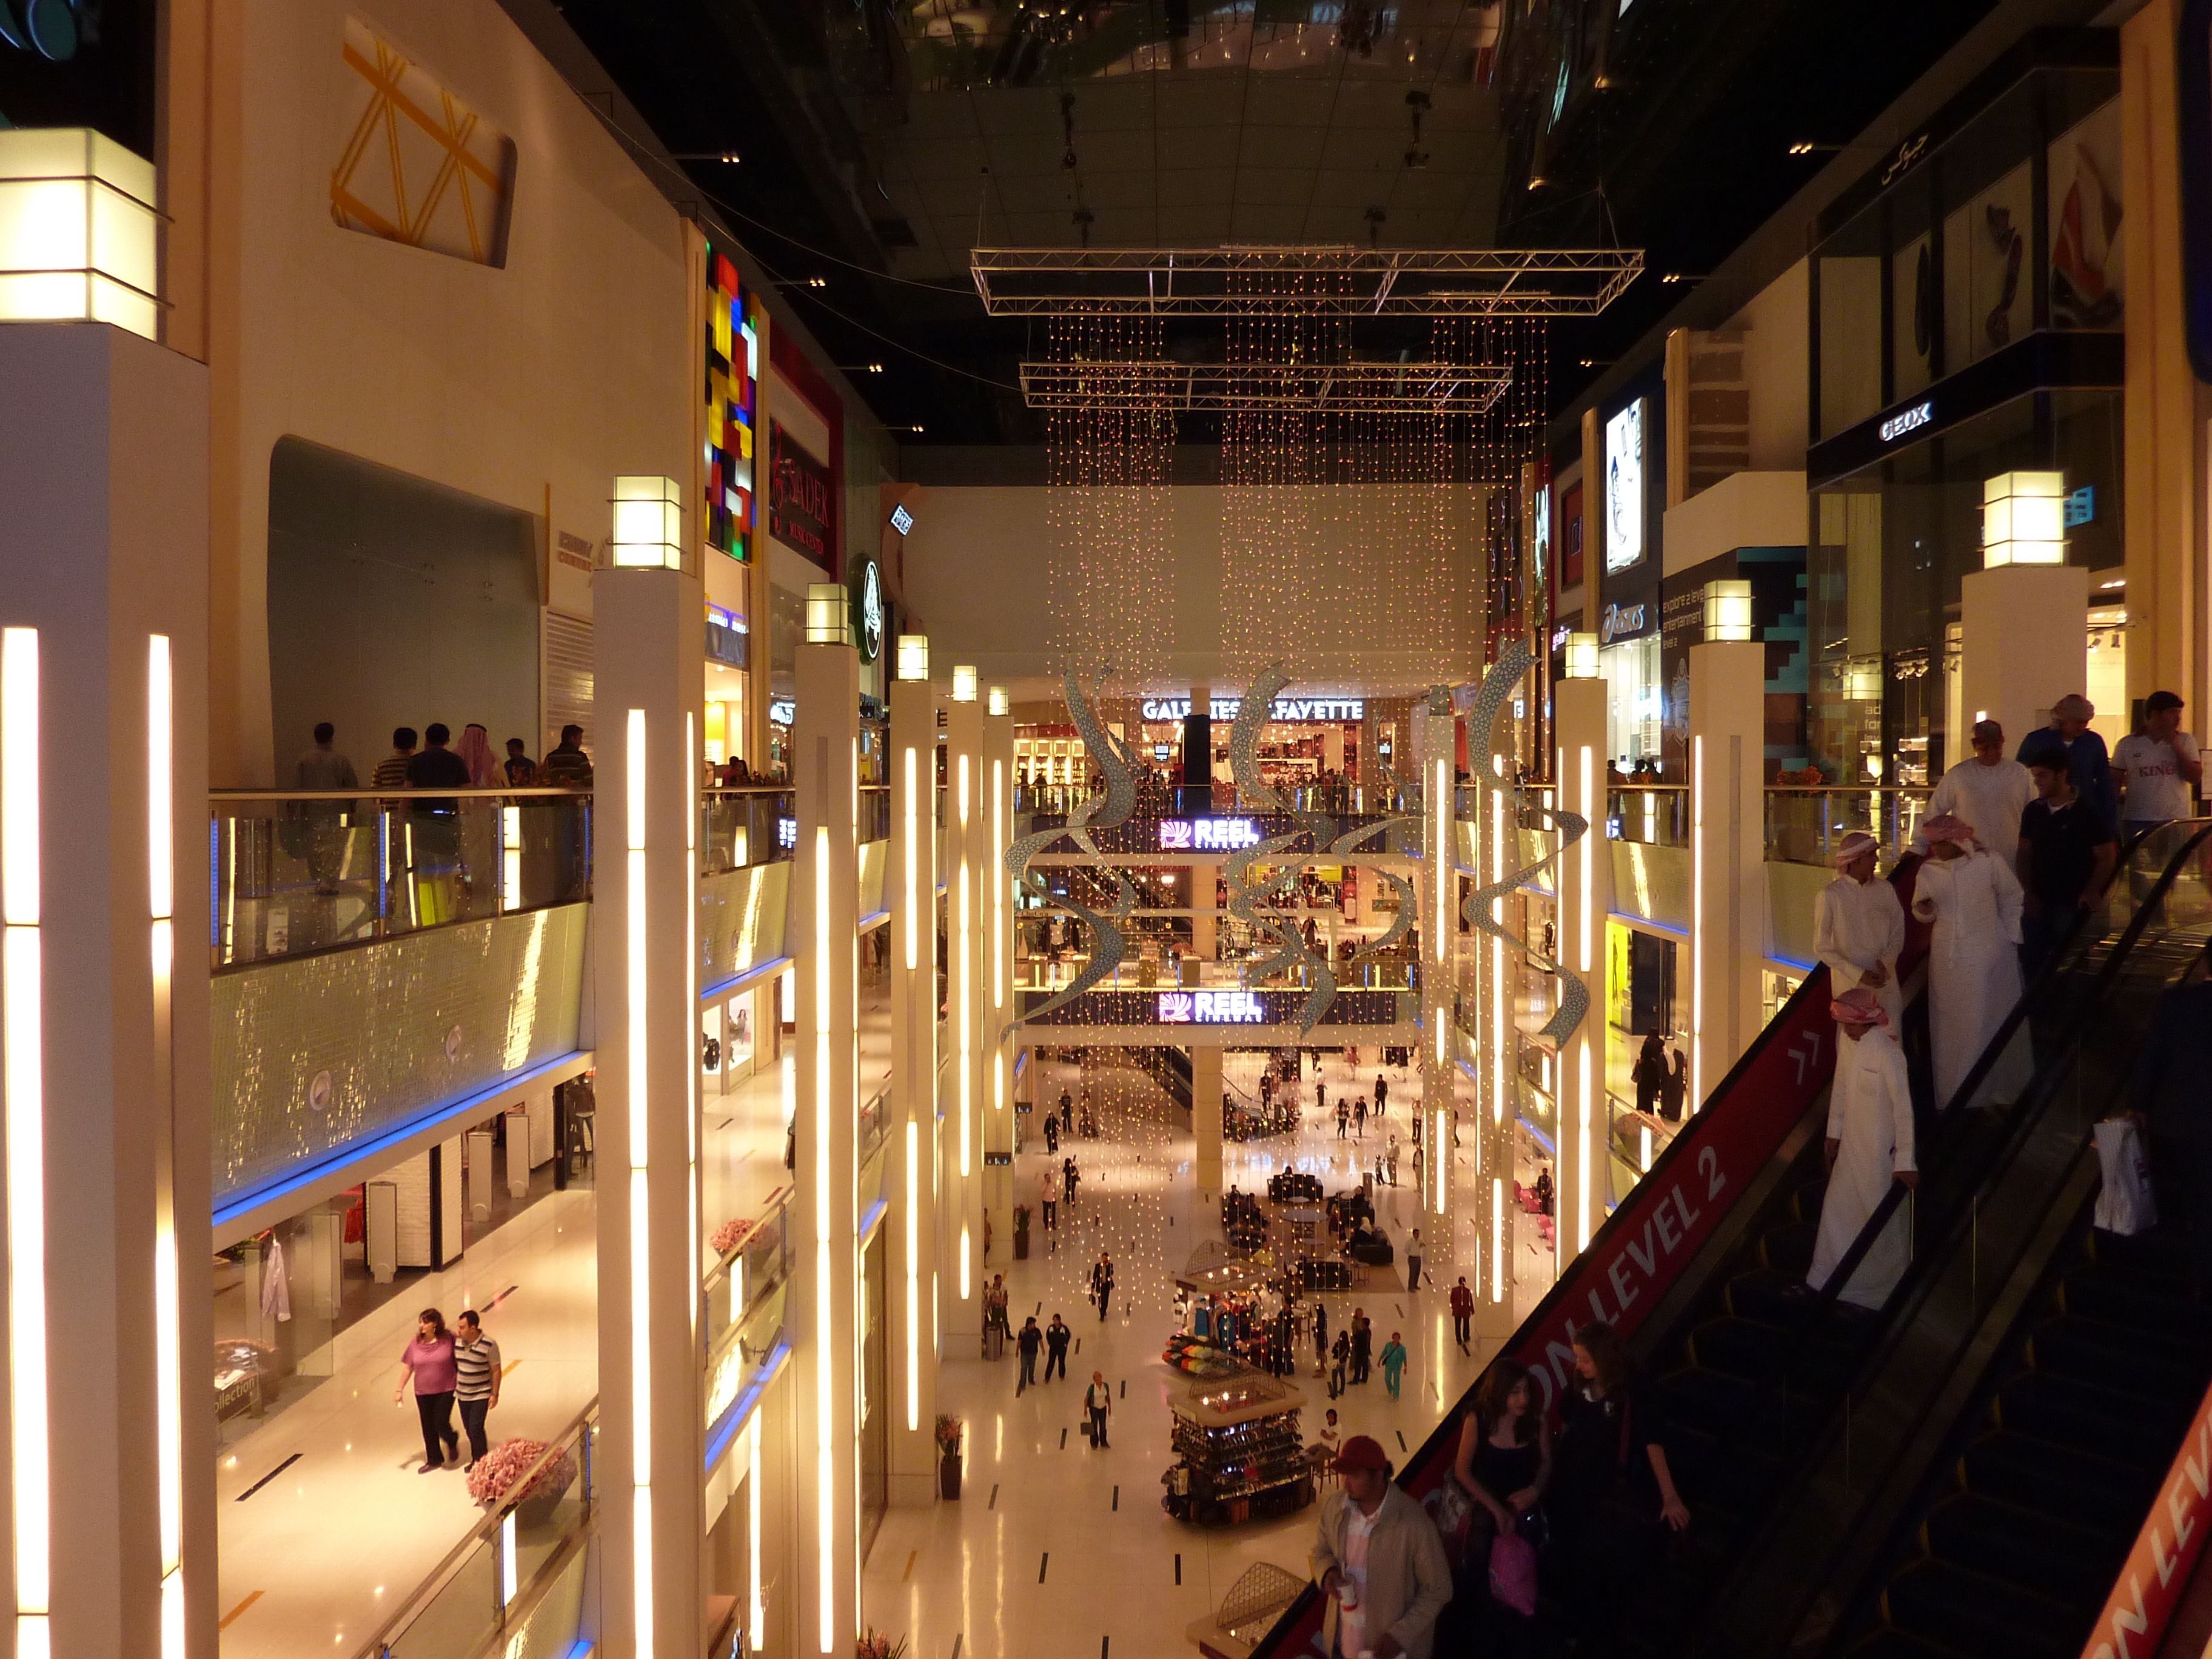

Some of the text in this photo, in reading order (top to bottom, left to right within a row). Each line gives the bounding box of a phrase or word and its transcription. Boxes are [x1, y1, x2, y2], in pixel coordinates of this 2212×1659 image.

[1879, 402, 1932, 441] GEOX
[1268, 700, 1363, 720] FAYETTE
[1194, 820, 1259, 842] REEL
[1195, 992, 1262, 1016] REEL
[1587, 1183, 1701, 1327] LEVEL
[1697, 1145, 1727, 1203] 2
[214, 1378, 255, 1414] ollection
[2150, 1406, 2212, 1589] LEV
